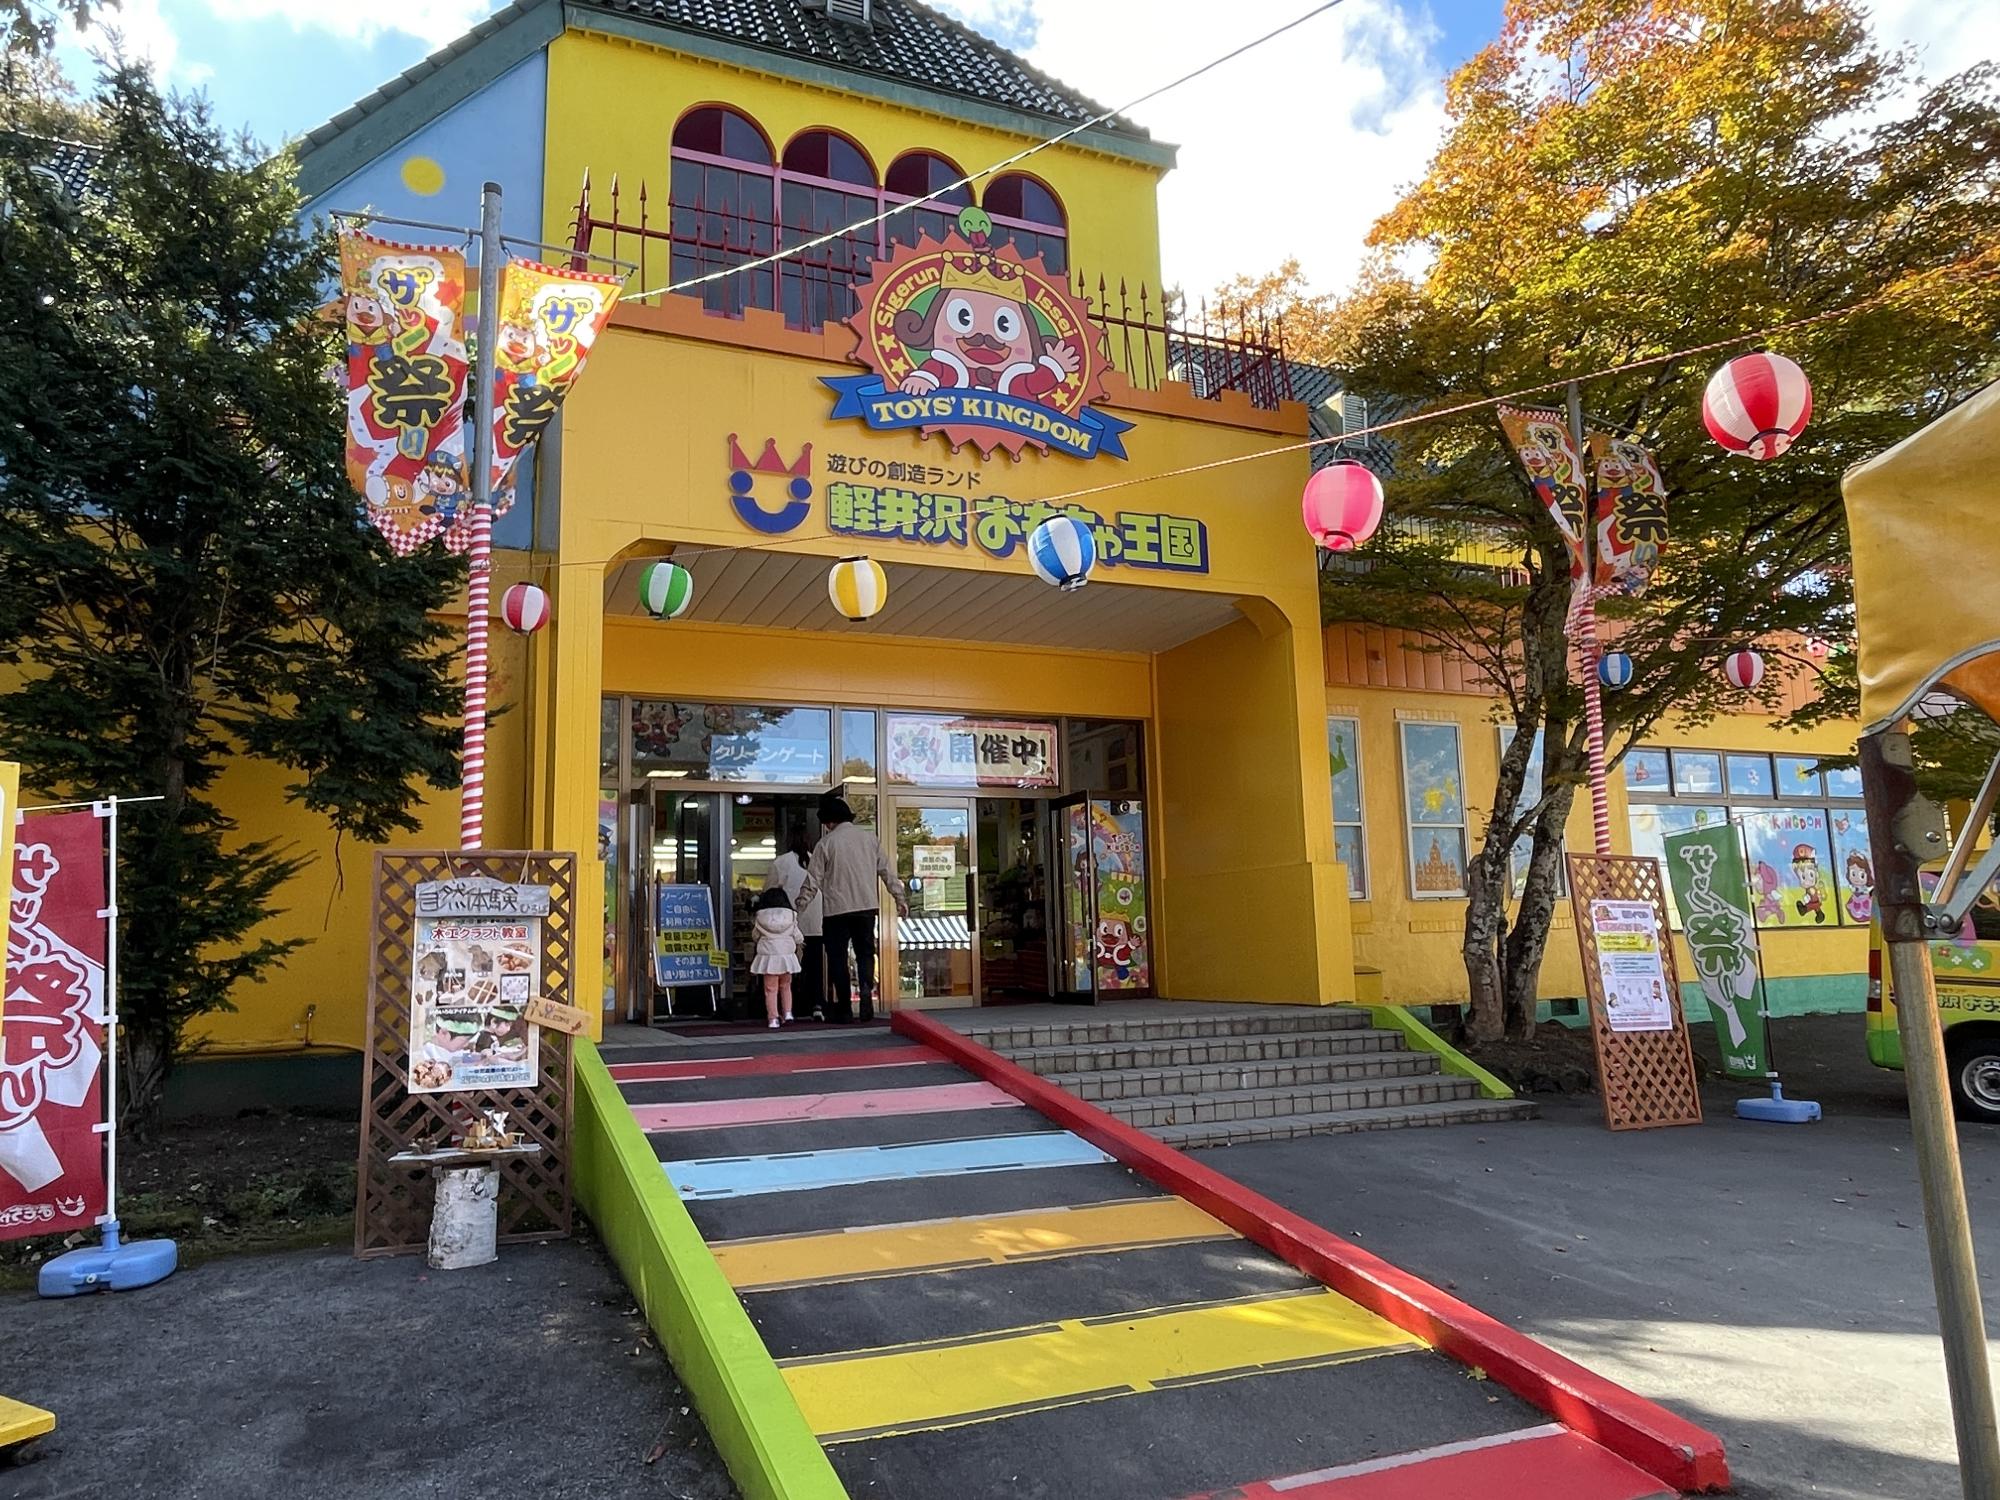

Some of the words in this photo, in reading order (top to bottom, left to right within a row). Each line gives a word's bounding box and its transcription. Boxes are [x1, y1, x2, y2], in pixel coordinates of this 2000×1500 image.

[877, 265, 941, 329] Sigerun
[1034, 287, 1079, 338] Issei
[871, 397, 956, 423] TOYS'
[960, 398, 1092, 452] KINGDOM
[826, 453, 982, 489] 遊びの創造ランド
[828, 482, 965, 544] 軽井沢
[714, 743, 825, 765] クリーンゲート
[1963, 995, 2000, 1012] おも
